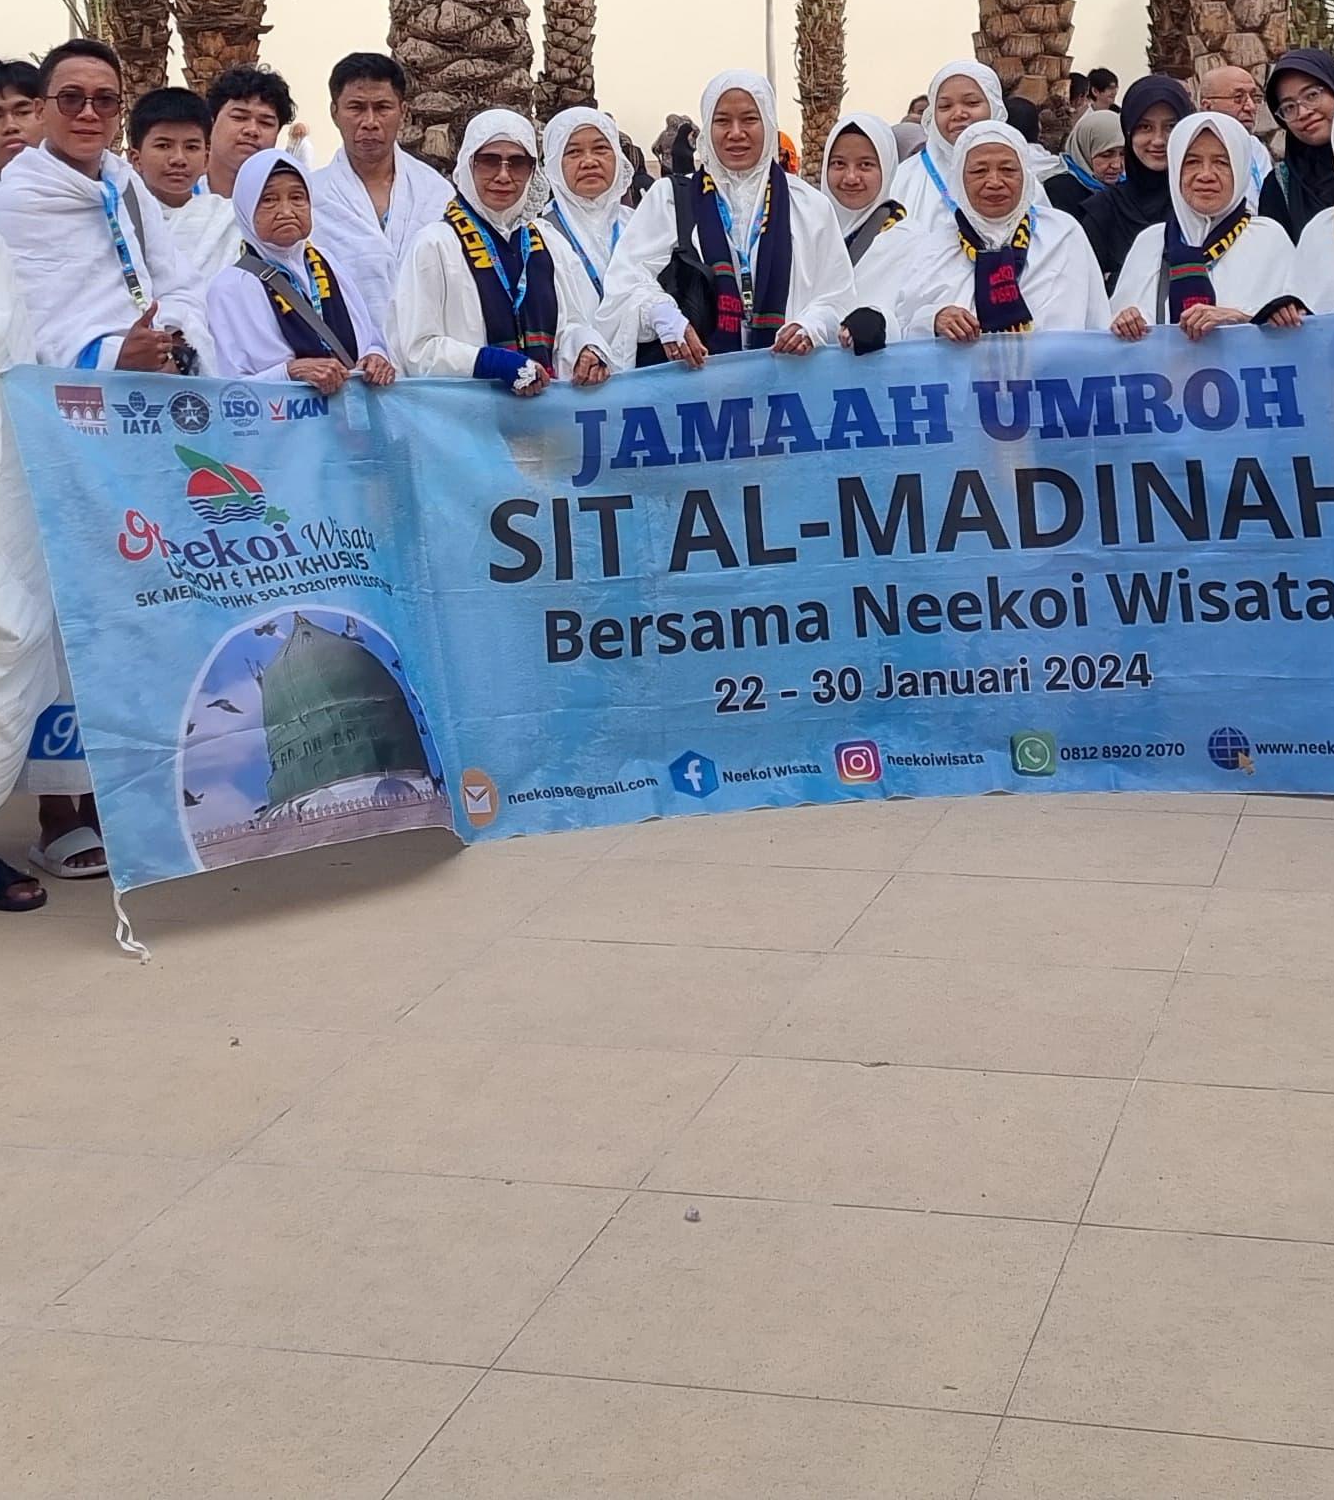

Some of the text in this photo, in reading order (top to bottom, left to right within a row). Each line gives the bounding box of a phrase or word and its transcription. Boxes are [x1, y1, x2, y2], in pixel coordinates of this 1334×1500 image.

[223, 400, 260, 418] ISO
[287, 396, 329, 419] KAN
[122, 419, 163, 435] IATA
[571, 364, 1305, 488] JAMAAH UMROH
[488, 495, 634, 583] SIT
[230, 571, 244, 589] &
[245, 560, 295, 588] HAJI
[296, 550, 369, 577] KHUSUS
[135, 590, 161, 608] SK
[220, 593, 259, 609] PIHK
[544, 599, 830, 664] Bersama
[853, 572, 1089, 639] Neekoi
[714, 674, 767, 714] 22
[811, 666, 863, 706] 30
[875, 657, 1032, 700] Januari
[1043, 652, 1153, 692] 2024
[886, 752, 985, 767] neekoiwisata
[1060, 742, 1186, 760] 0812 8920 2070
[722, 763, 822, 783] Neekoi Wisata
[507, 776, 659, 805] neekoi98@gmail.com
